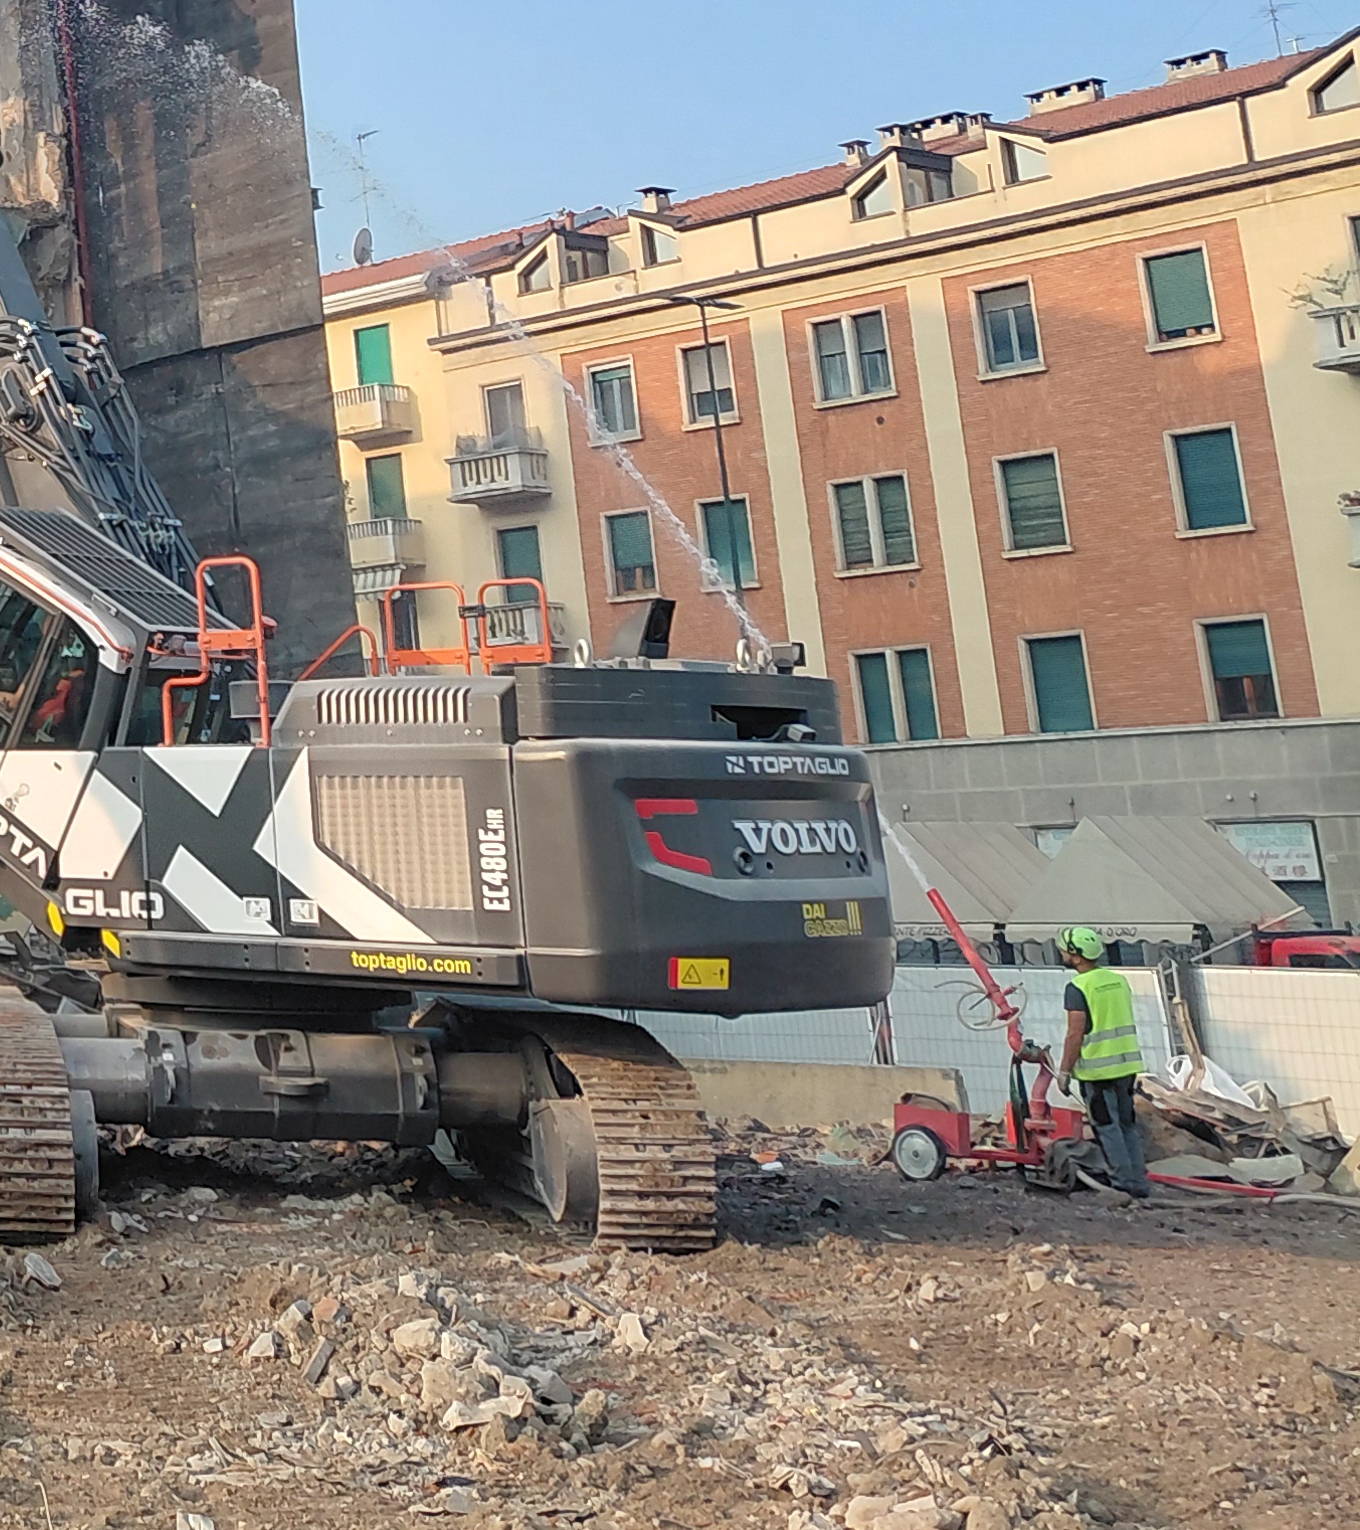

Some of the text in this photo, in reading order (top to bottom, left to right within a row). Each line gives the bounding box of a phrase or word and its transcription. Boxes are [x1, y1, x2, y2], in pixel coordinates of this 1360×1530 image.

[746, 756, 850, 776] TOPTAGLIO
[732, 820, 858, 855] VOLVO
[802, 903, 827, 920] DAI
[350, 951, 472, 975] toptaglio.com
